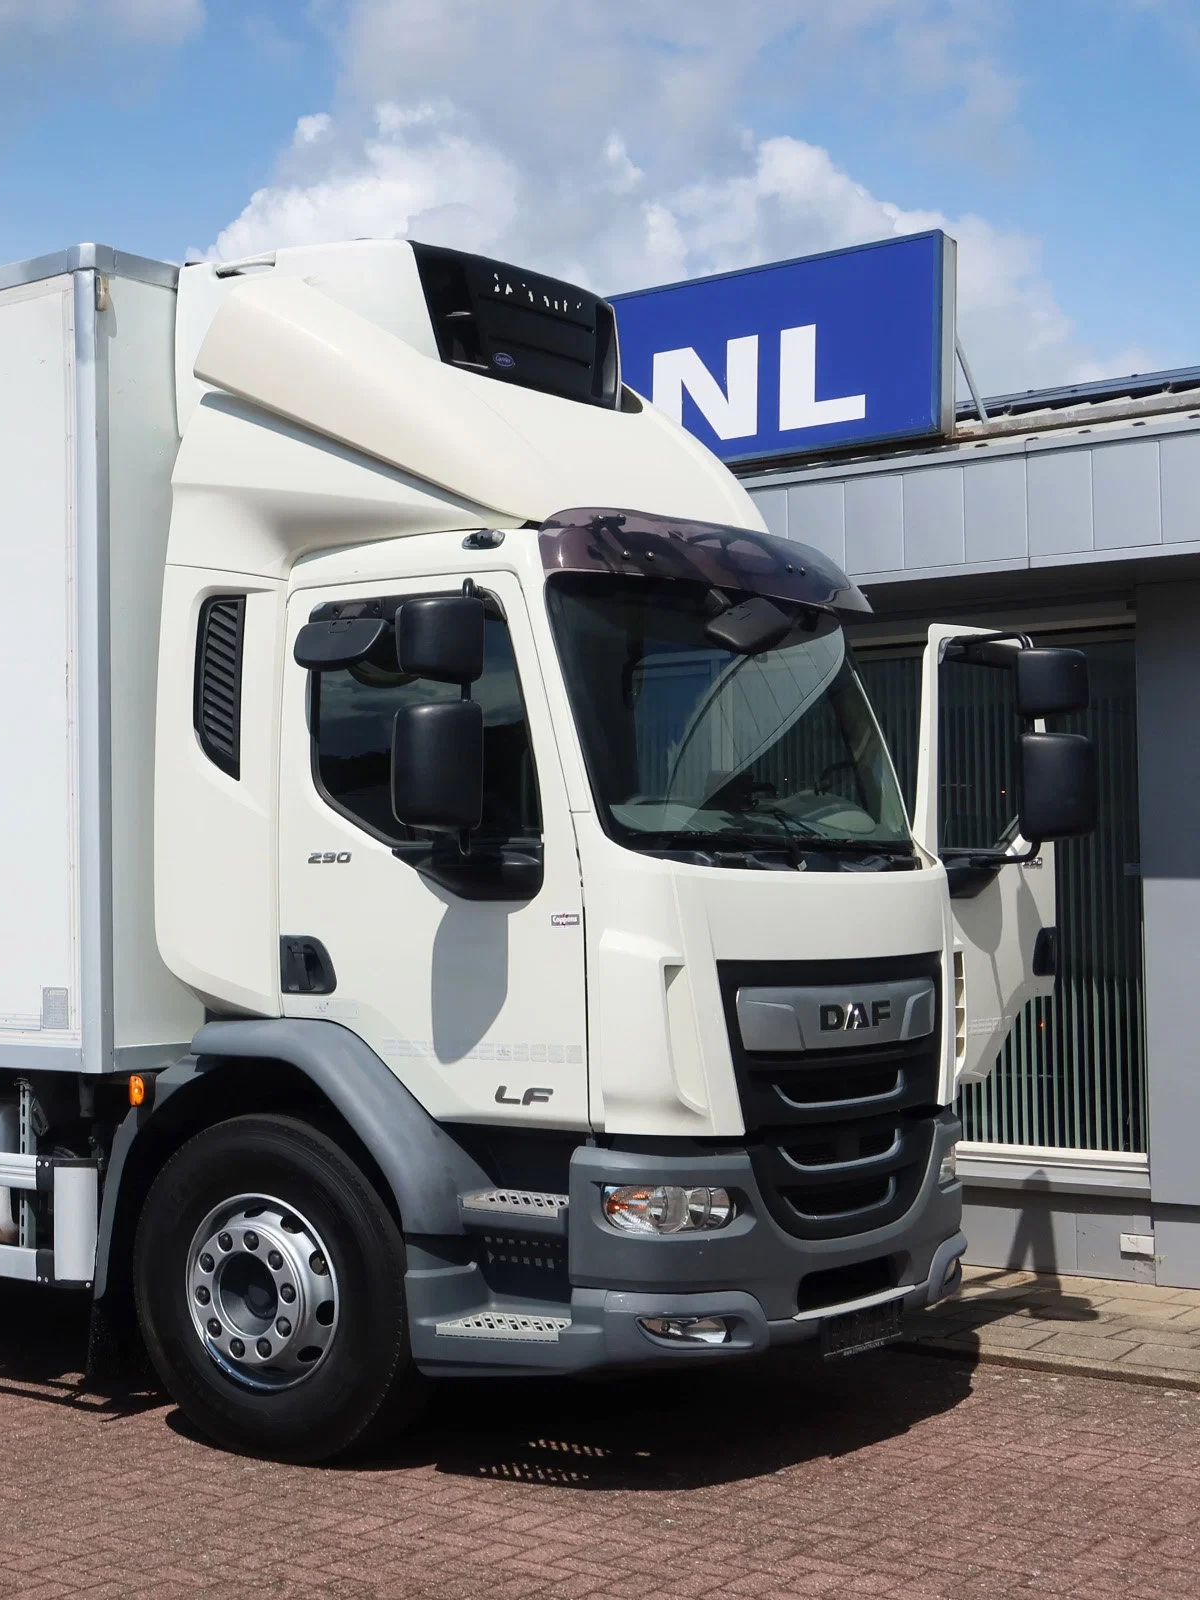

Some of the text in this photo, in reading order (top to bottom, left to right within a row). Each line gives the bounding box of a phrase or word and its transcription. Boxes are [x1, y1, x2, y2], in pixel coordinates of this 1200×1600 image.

[653, 323, 866, 440] NL
[308, 852, 352, 864] 290
[819, 1000, 891, 1030] DAF
[494, 1085, 554, 1105] LF
